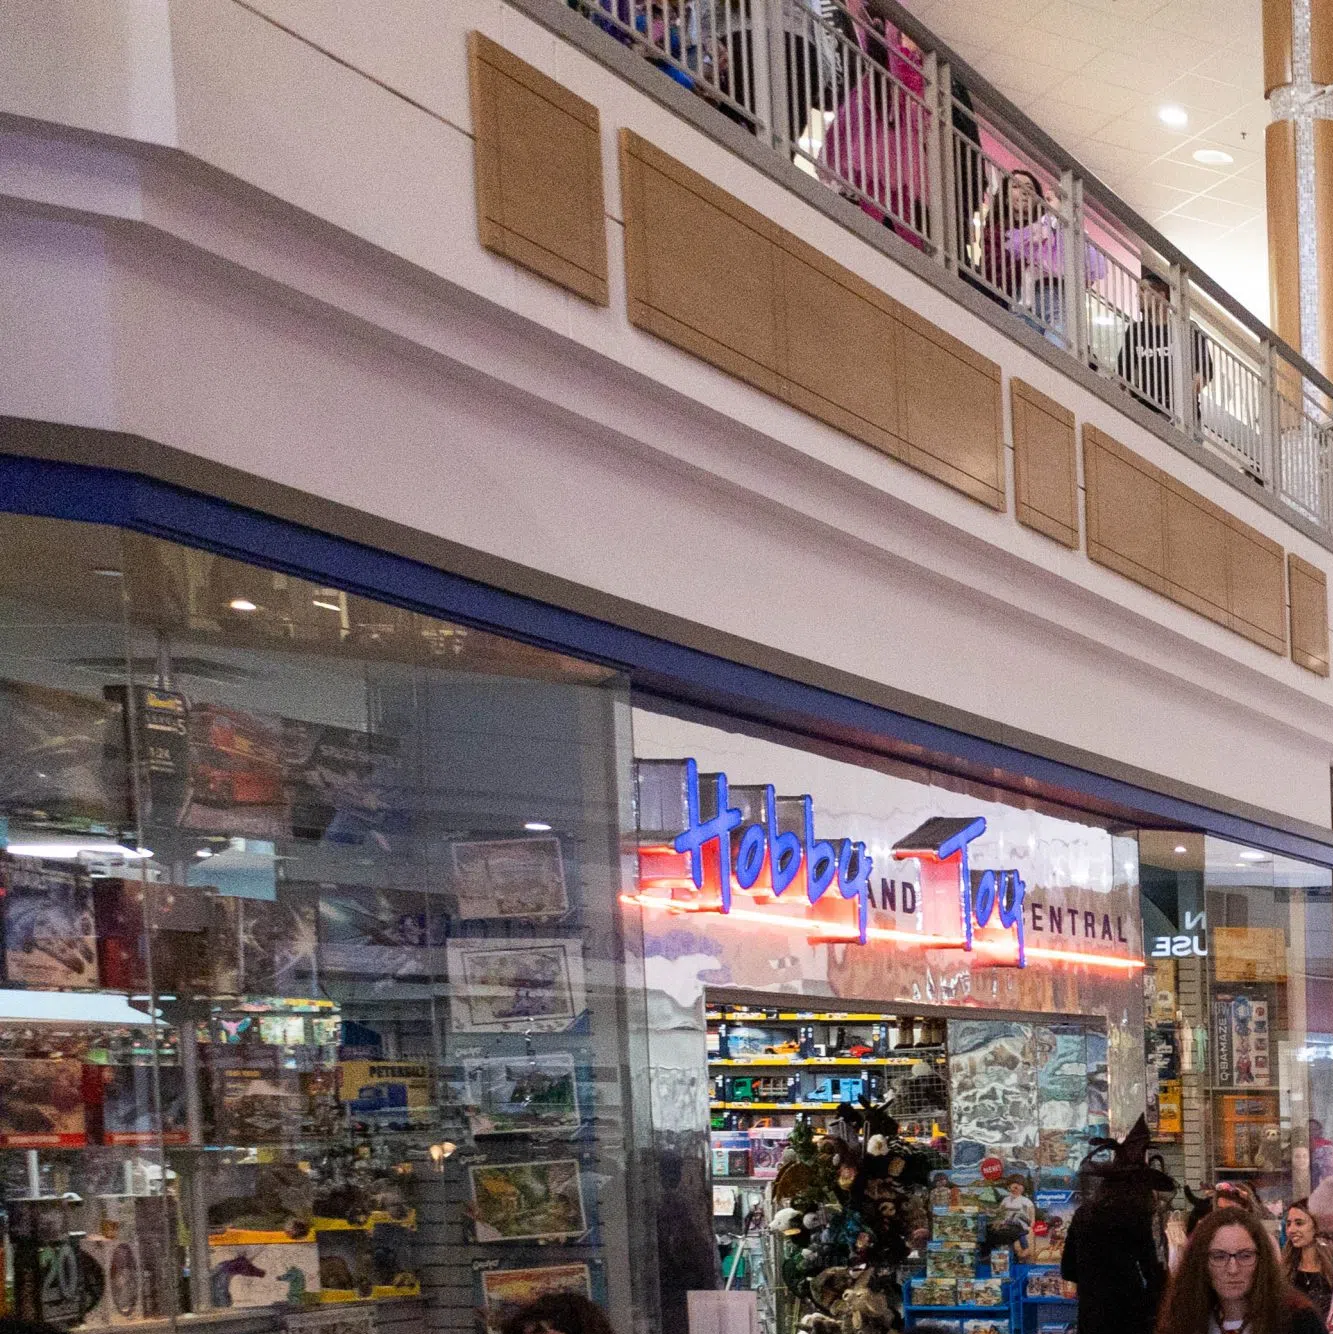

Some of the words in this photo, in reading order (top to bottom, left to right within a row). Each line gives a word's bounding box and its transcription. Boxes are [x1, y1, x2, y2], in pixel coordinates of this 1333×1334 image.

[674, 757, 873, 945] Hobby
[937, 816, 1026, 968] Toy
[1023, 902, 1128, 943] ENTRAL
